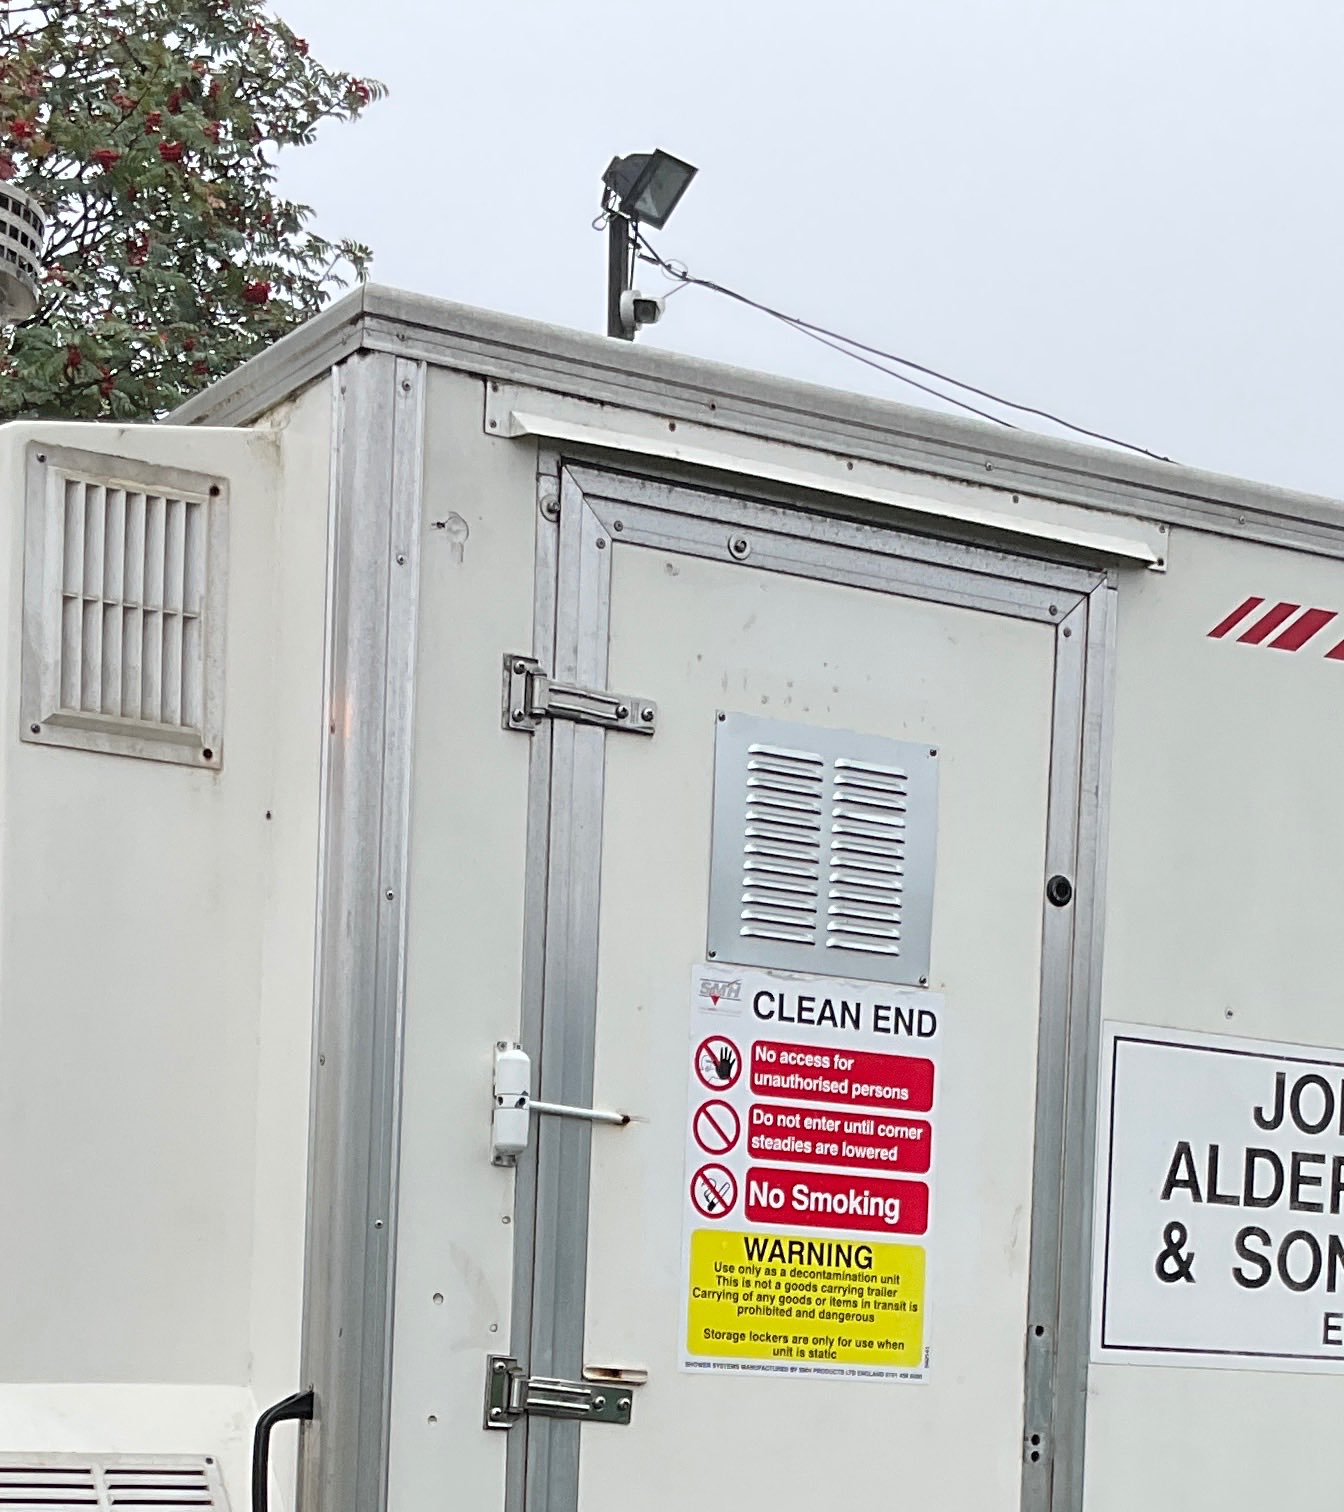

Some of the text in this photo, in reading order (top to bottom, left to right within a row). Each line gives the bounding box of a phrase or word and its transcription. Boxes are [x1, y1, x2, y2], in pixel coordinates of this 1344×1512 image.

[753, 990, 937, 1038] CLEAN END
[755, 1046, 855, 1071] No access for
[754, 1072, 909, 1100] unauthorised persons
[752, 1109, 923, 1141] Do not enter until corner
[751, 1135, 898, 1161] steadies are lowered
[749, 1180, 900, 1224] No Smoking
[744, 1237, 873, 1269] WARNING
[1155, 1221, 1196, 1283] &
[714, 1261, 900, 1285] Use only as a decontamination unit
[716, 1275, 898, 1298] This is not a goods carrying trailer
[692, 1287, 918, 1312] Carrying of any goods or items in transit is
[737, 1305, 874, 1323] prohibited and dangerous
[704, 1328, 905, 1350] Storage lockers are only for use when
[773, 1347, 837, 1359] unit is static
